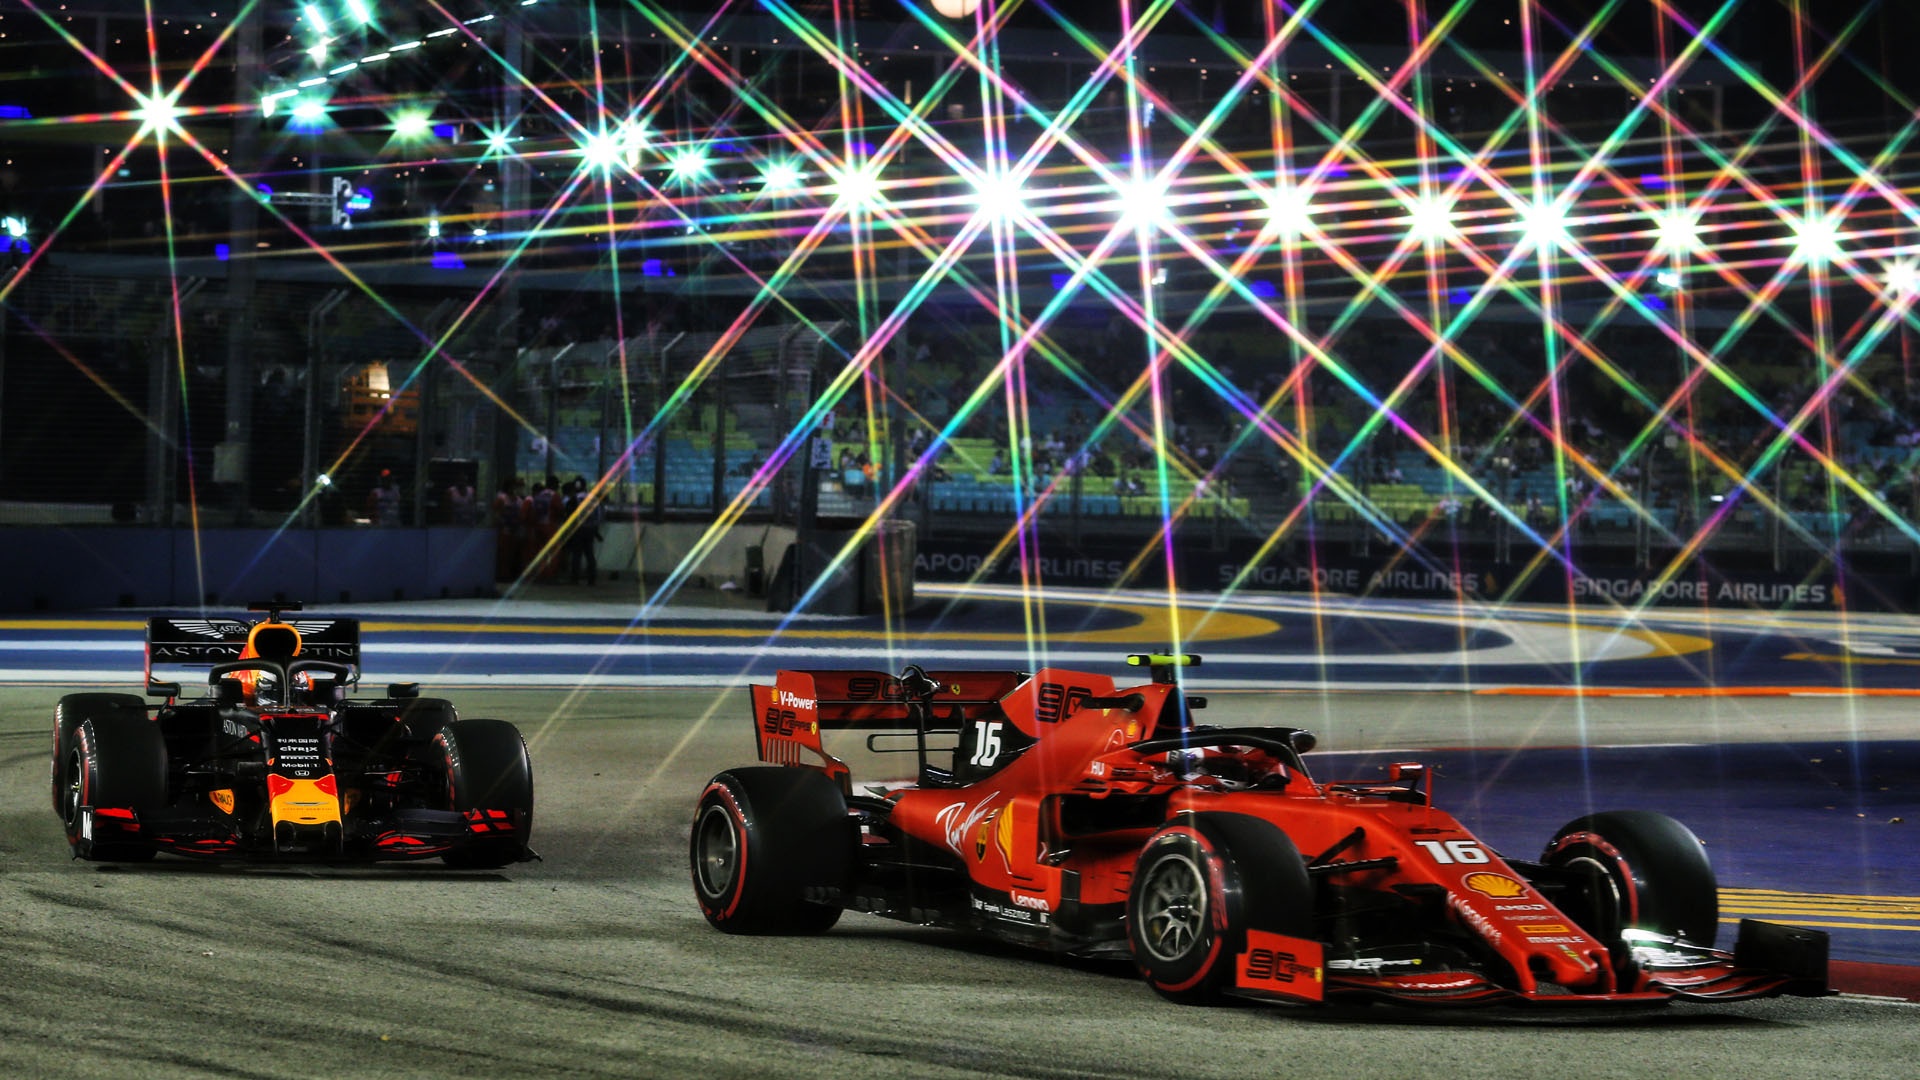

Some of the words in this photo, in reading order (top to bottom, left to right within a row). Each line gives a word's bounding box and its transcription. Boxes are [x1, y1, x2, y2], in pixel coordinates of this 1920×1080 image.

[914, 553, 998, 573] APORE
[1008, 558, 1123, 579] AIRLINES
[1218, 564, 1360, 588] SINGAPORE
[1367, 570, 1479, 591] AIRLINES
[1572, 578, 1709, 600] SINGAPORE
[1717, 581, 1827, 602] AIRLINES
[779, 690, 815, 710] V-Power
[970, 720, 1004, 767] 16
[1414, 840, 1490, 864] 16
[1011, 889, 1050, 912] Lenovo
